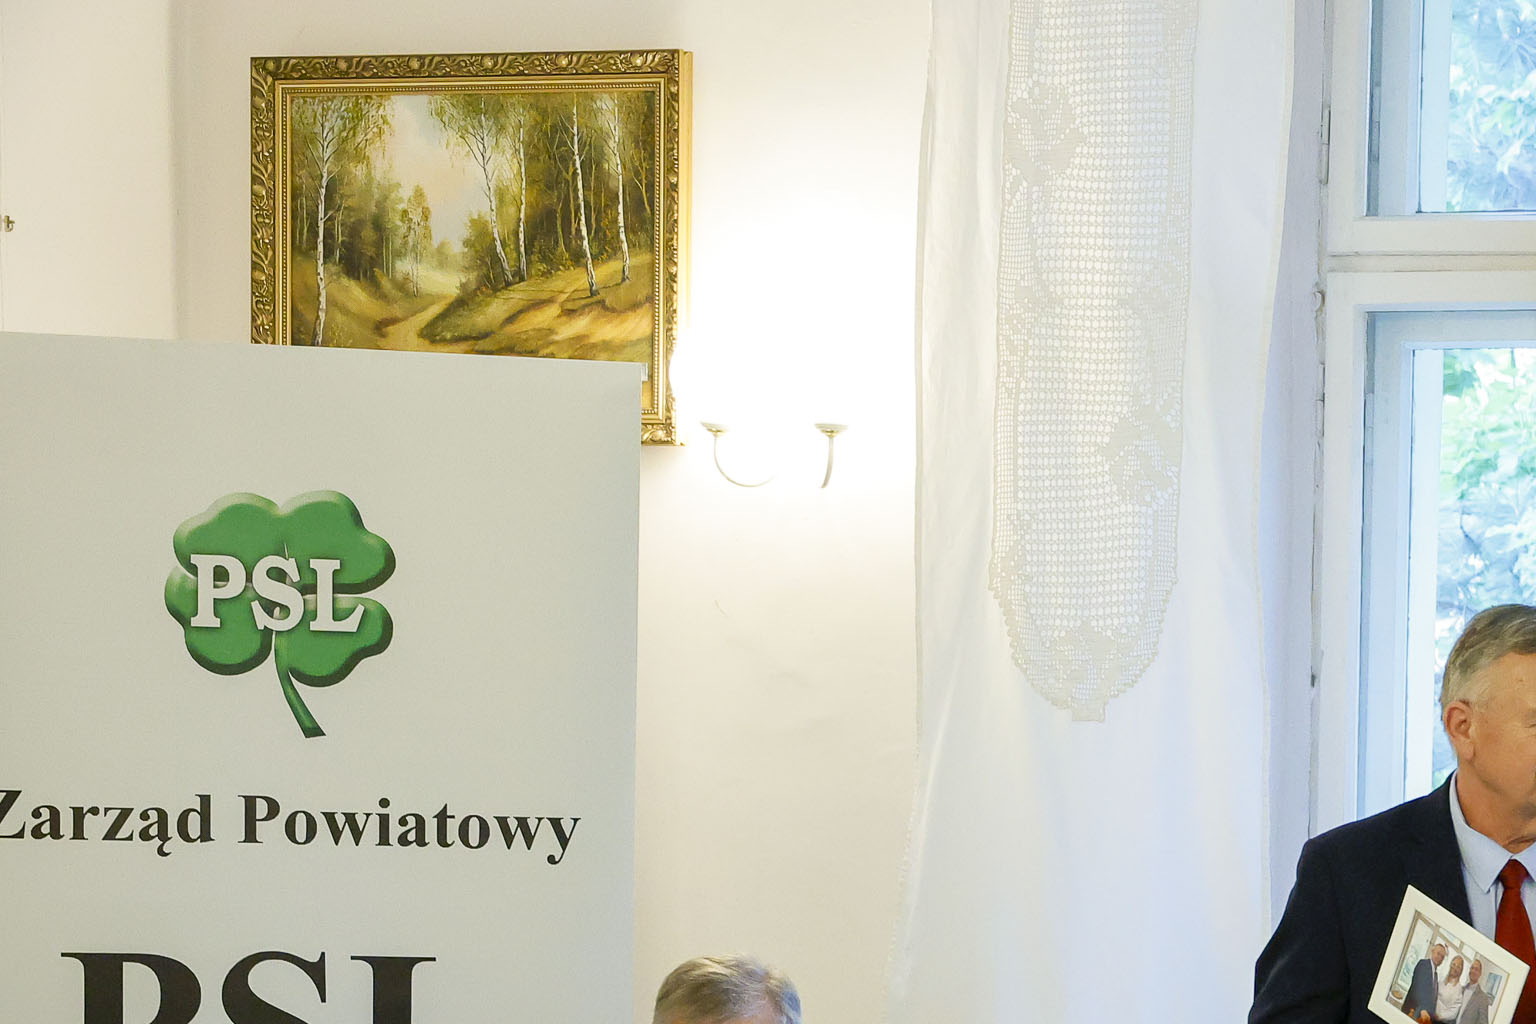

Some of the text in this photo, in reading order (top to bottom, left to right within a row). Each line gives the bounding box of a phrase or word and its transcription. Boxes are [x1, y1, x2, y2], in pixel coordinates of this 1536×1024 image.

[190, 554, 365, 632] PSL
[0, 789, 581, 866] Zarząd Powiatowy
